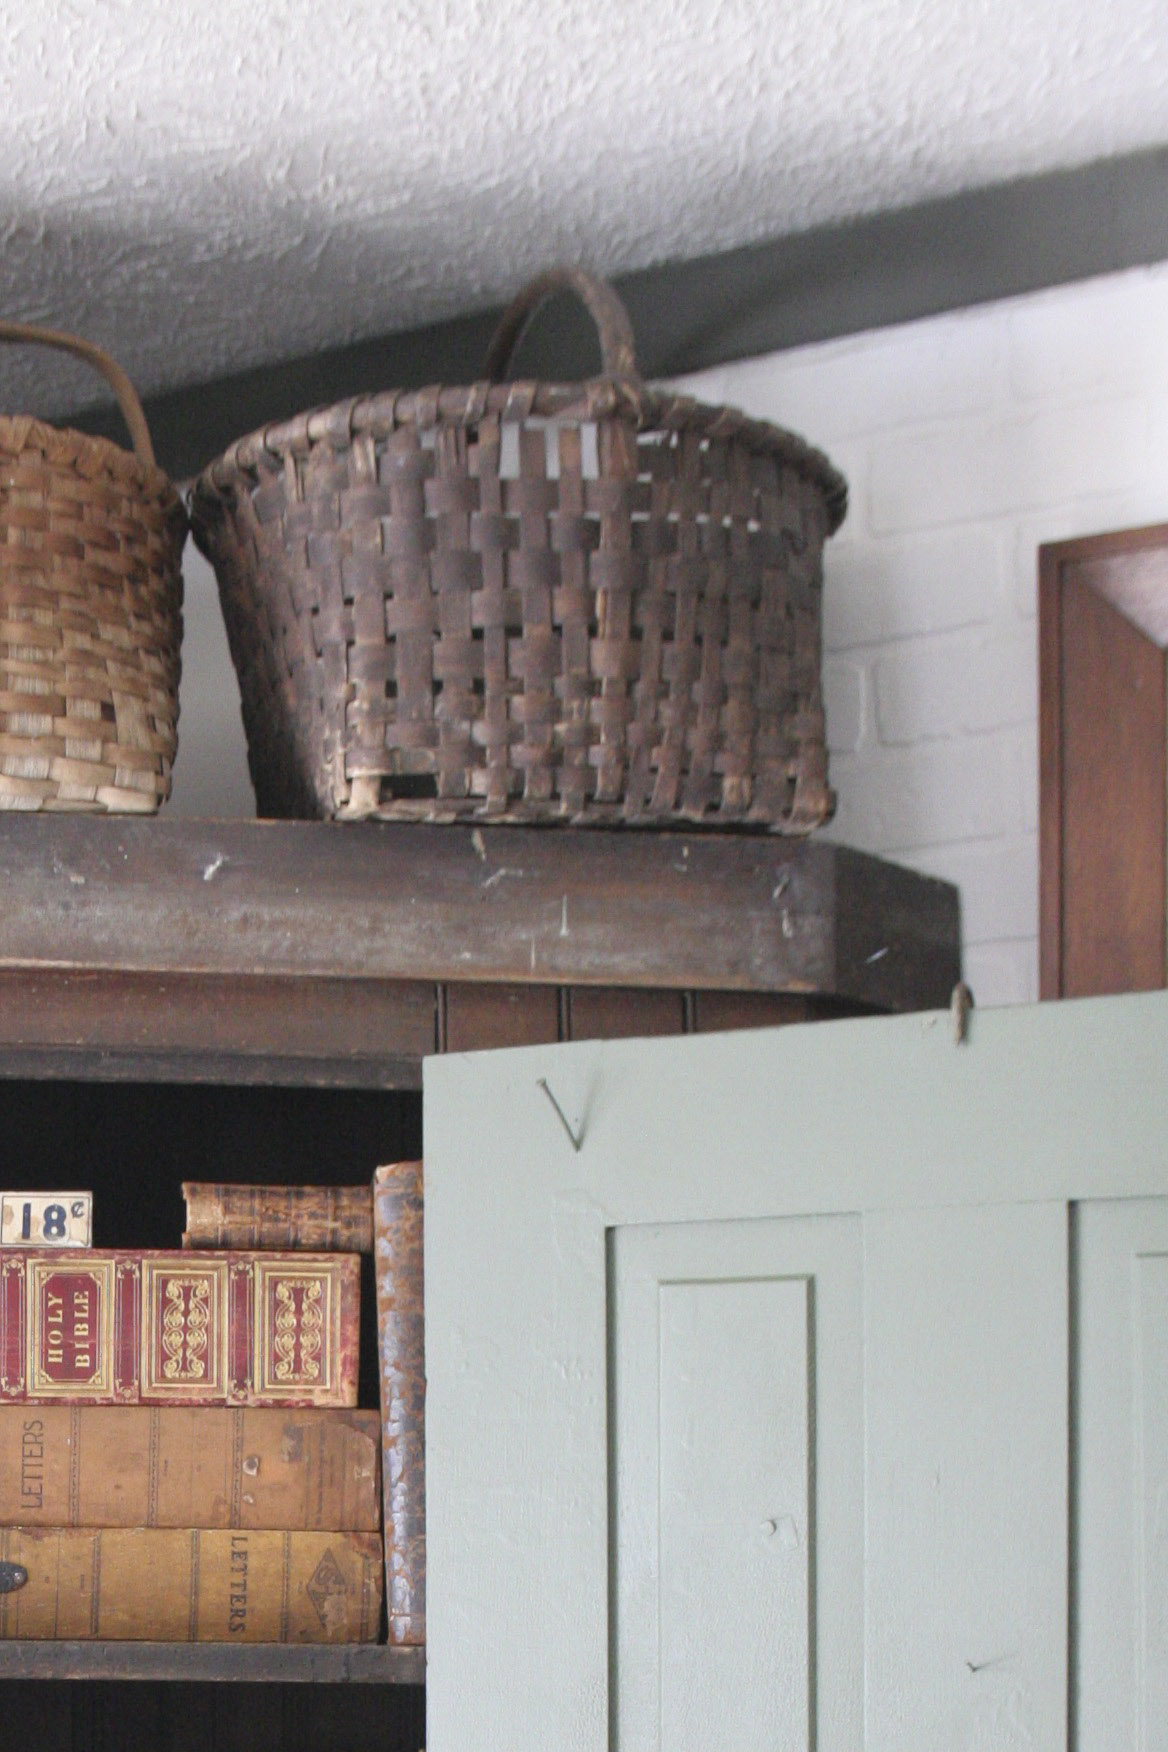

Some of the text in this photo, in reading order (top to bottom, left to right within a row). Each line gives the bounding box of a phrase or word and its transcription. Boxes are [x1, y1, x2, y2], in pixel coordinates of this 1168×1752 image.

[22, 1201, 84, 1242] 18¢
[47, 1292, 63, 1363] HOLY
[74, 1291, 90, 1368] BIBLE
[21, 1419, 44, 1510] LETTERS
[228, 1535, 248, 1633] LETTERS
